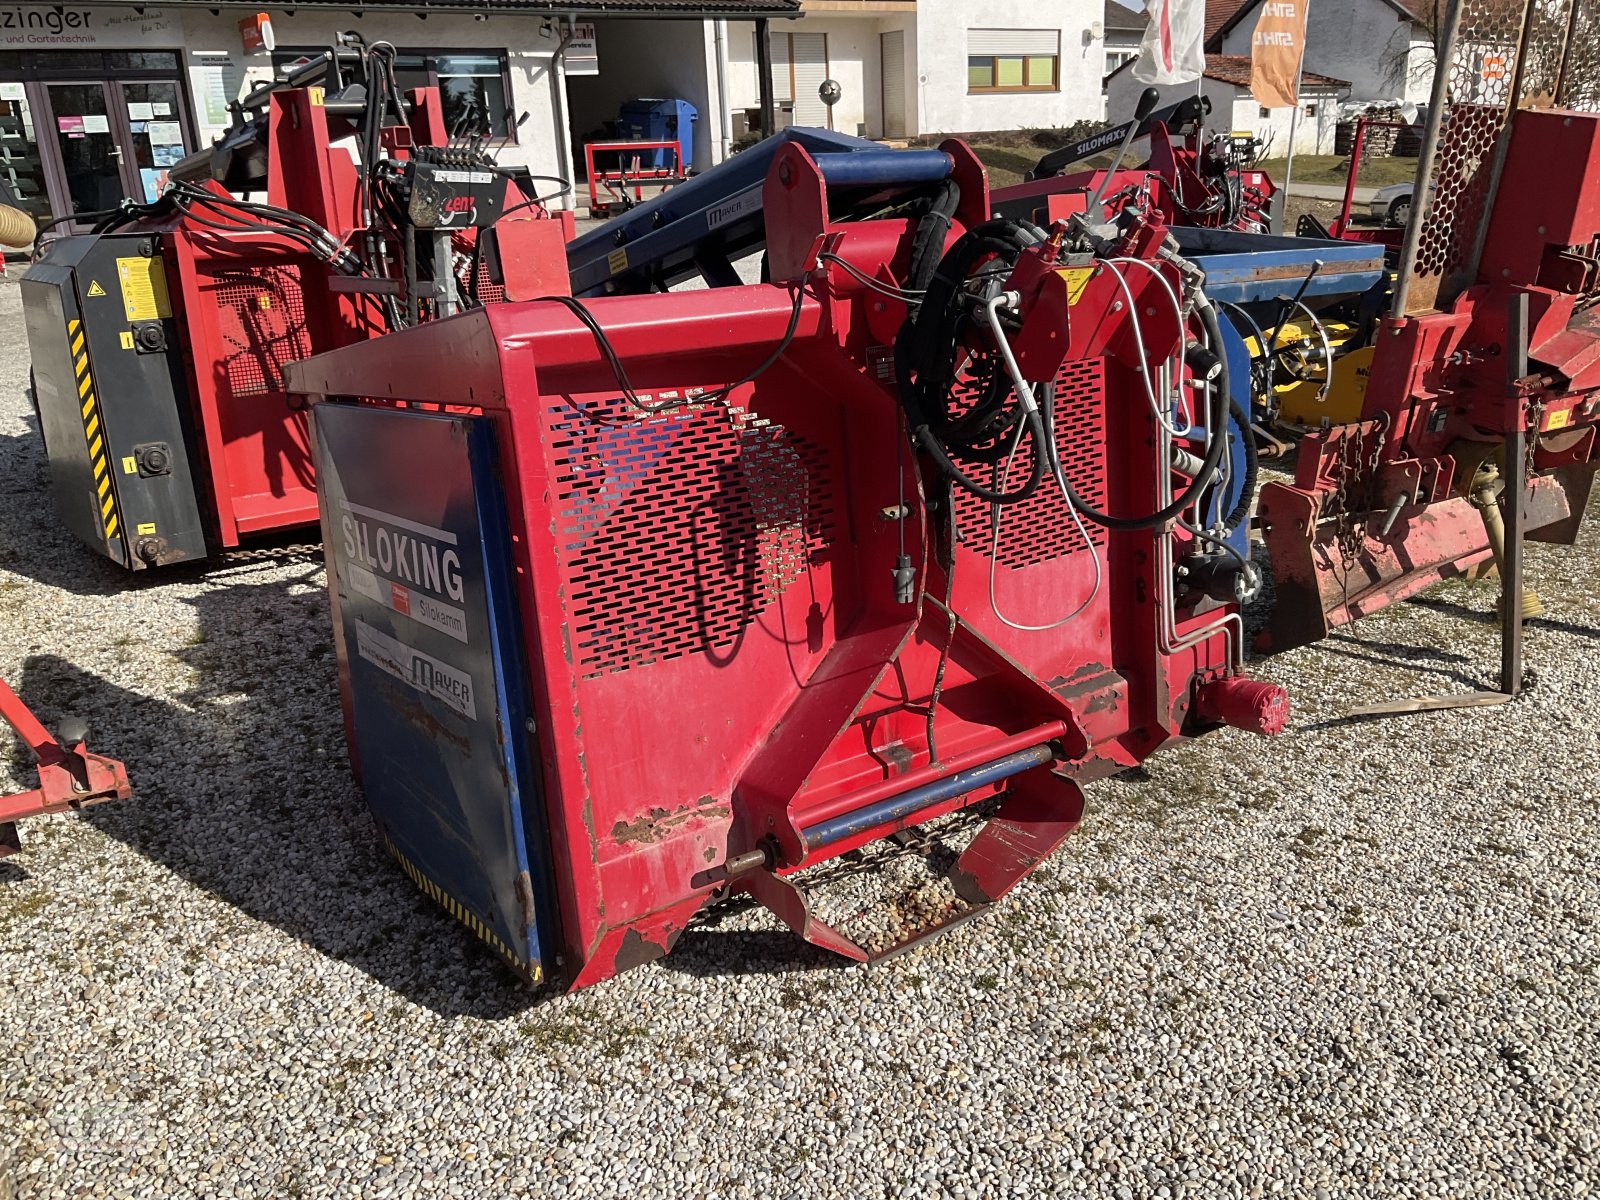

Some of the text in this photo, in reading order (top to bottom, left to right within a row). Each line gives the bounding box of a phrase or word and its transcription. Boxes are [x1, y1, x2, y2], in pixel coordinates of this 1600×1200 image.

[0, 7, 92, 34] zinger
[6, 34, 25, 43] und
[27, 34, 96, 44] Gartentechnik
[342, 514, 465, 604] SILOKING
[419, 599, 463, 632] Silokamm
[412, 655, 470, 702] MAYER
